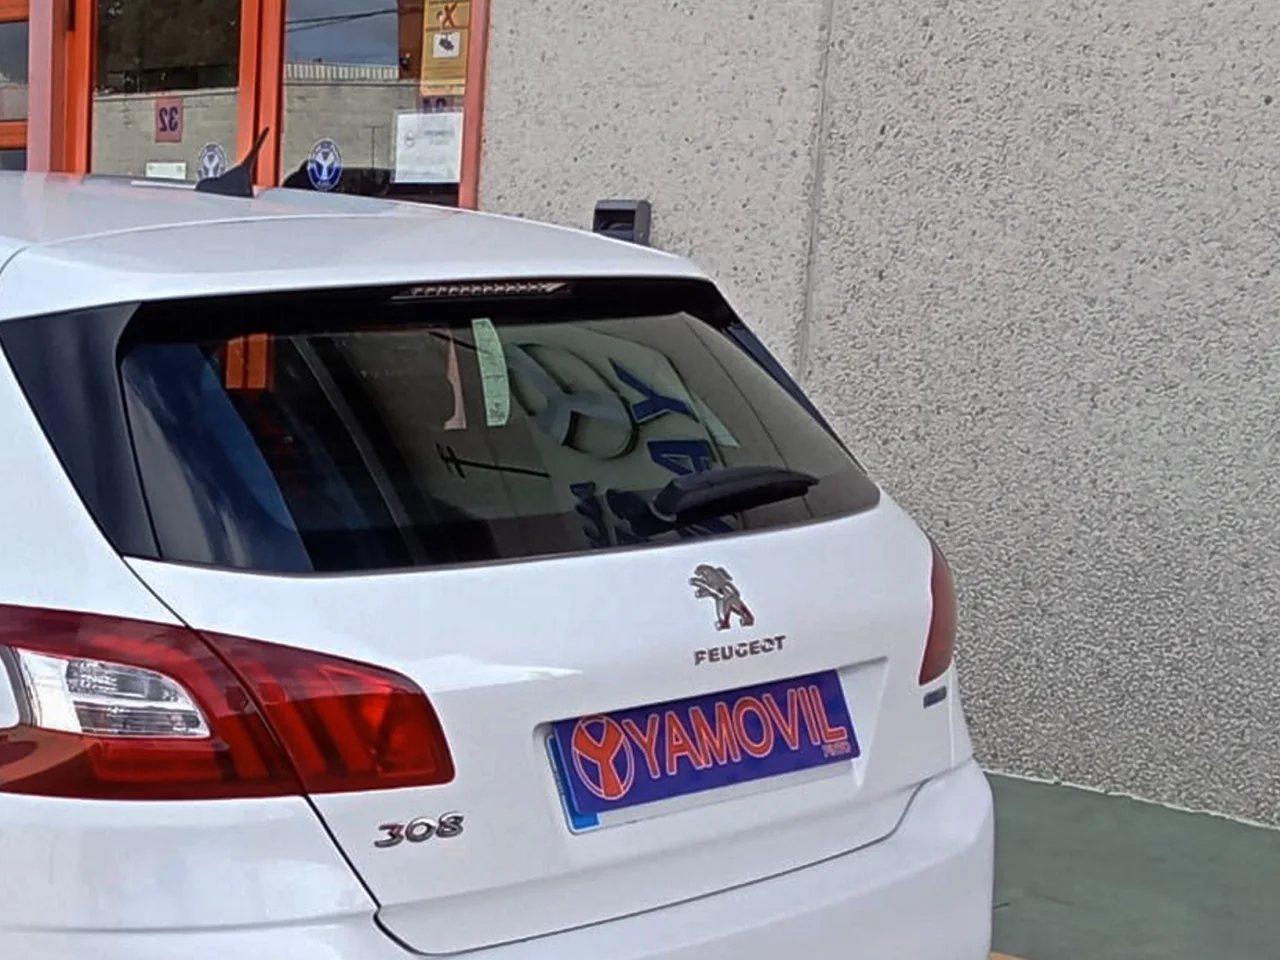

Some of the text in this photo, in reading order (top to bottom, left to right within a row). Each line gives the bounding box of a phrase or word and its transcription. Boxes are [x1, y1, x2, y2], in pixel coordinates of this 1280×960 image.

[694, 634, 787, 666] PEUGEOT
[623, 685, 848, 778] YAMOVIL
[373, 811, 464, 849] 308
